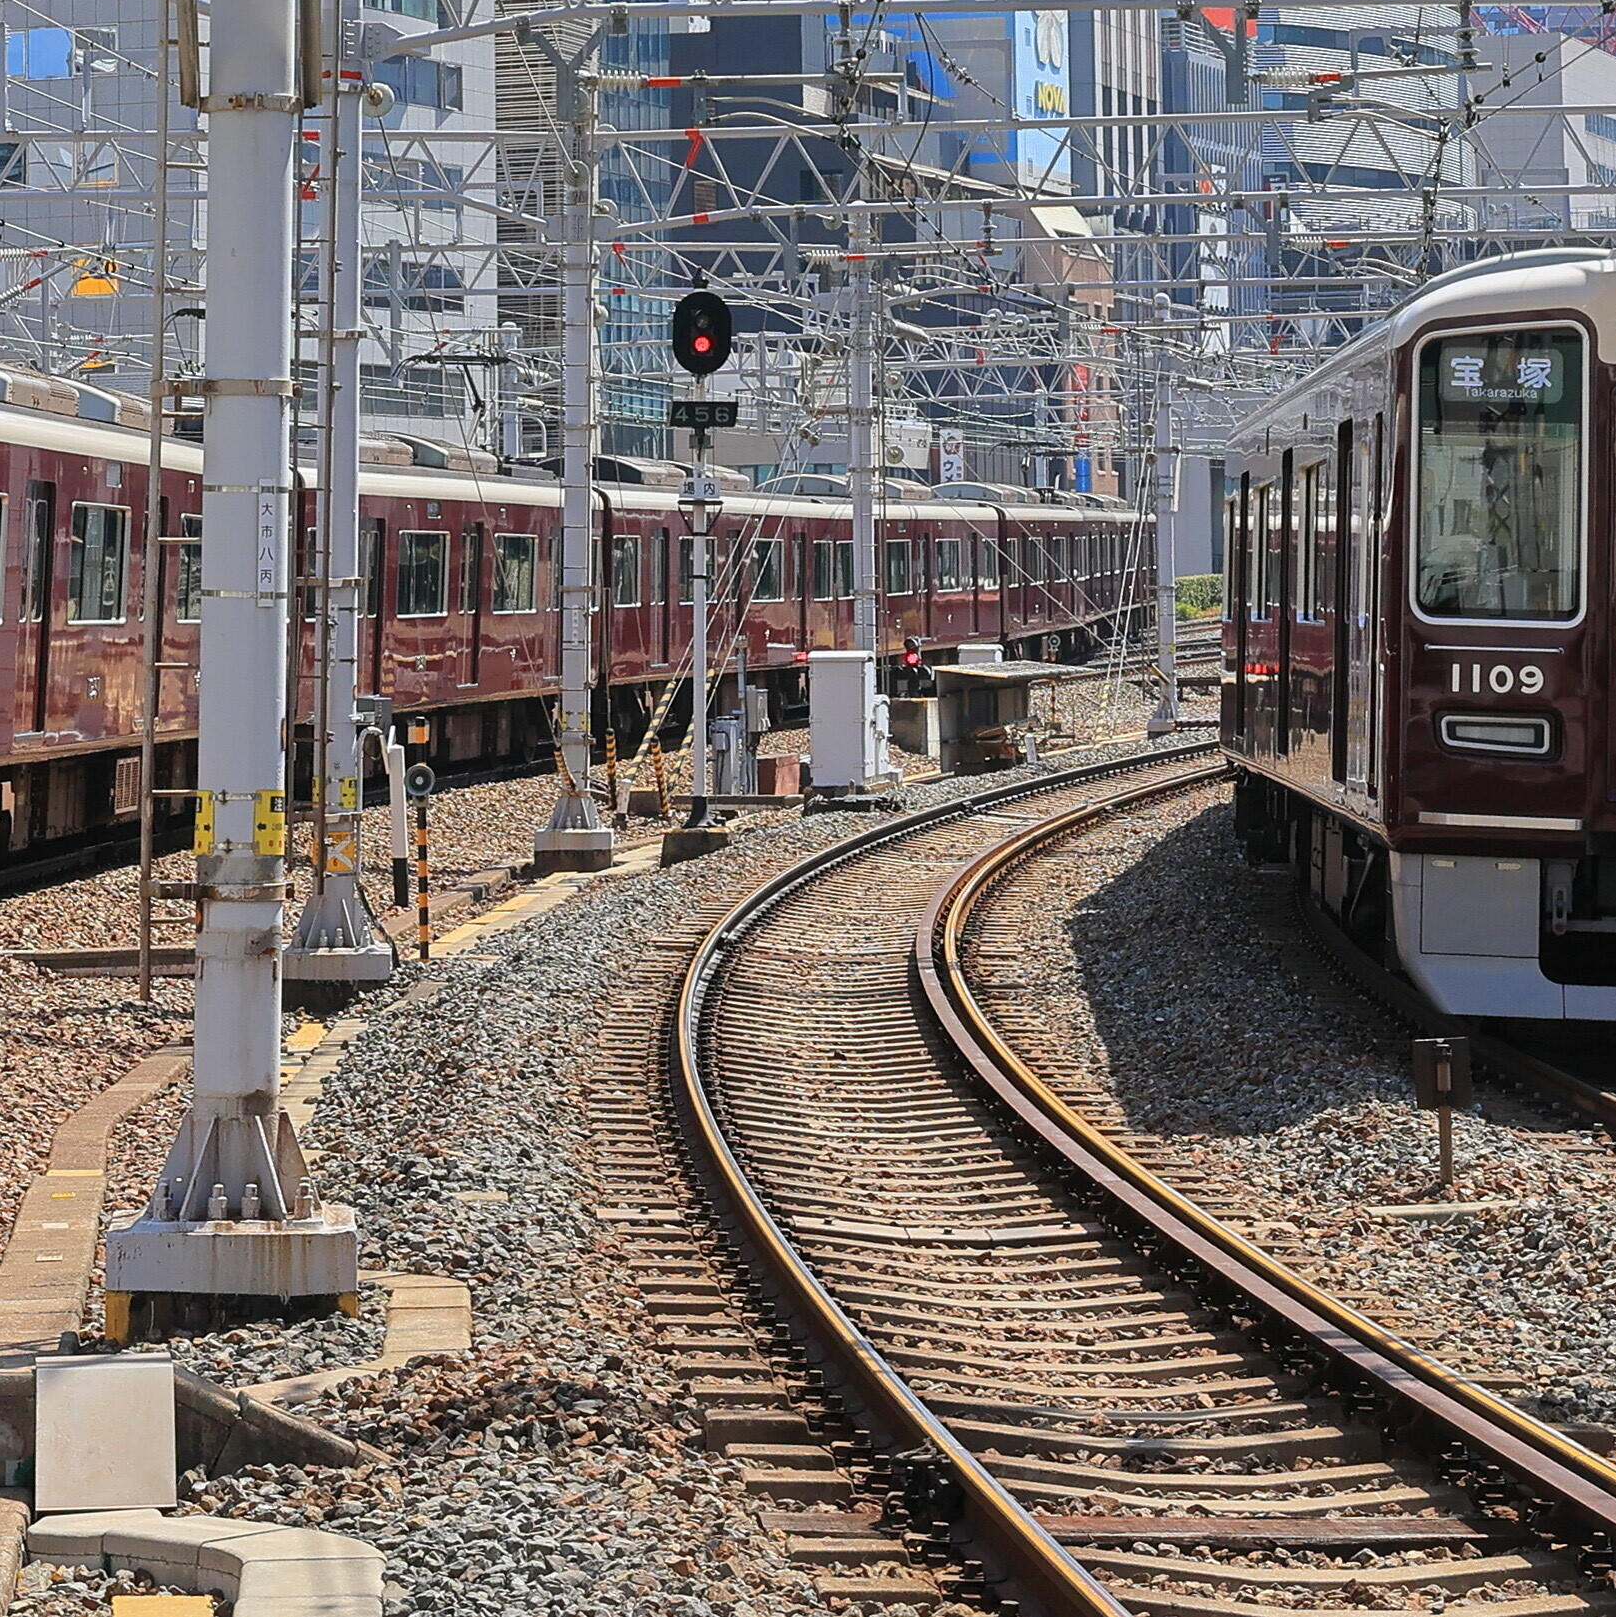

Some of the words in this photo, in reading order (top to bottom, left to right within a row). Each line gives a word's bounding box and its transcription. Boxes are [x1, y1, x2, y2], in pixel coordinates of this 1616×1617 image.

[1037, 81, 1065, 114] NOVA
[1450, 356, 1552, 388] 宝塚
[1464, 387, 1538, 399] Takarazuka
[675, 406, 730, 423] 456
[684, 482, 715, 496] 場内
[260, 502, 274, 584] 大市八丙
[1452, 664, 1544, 694] 1109
